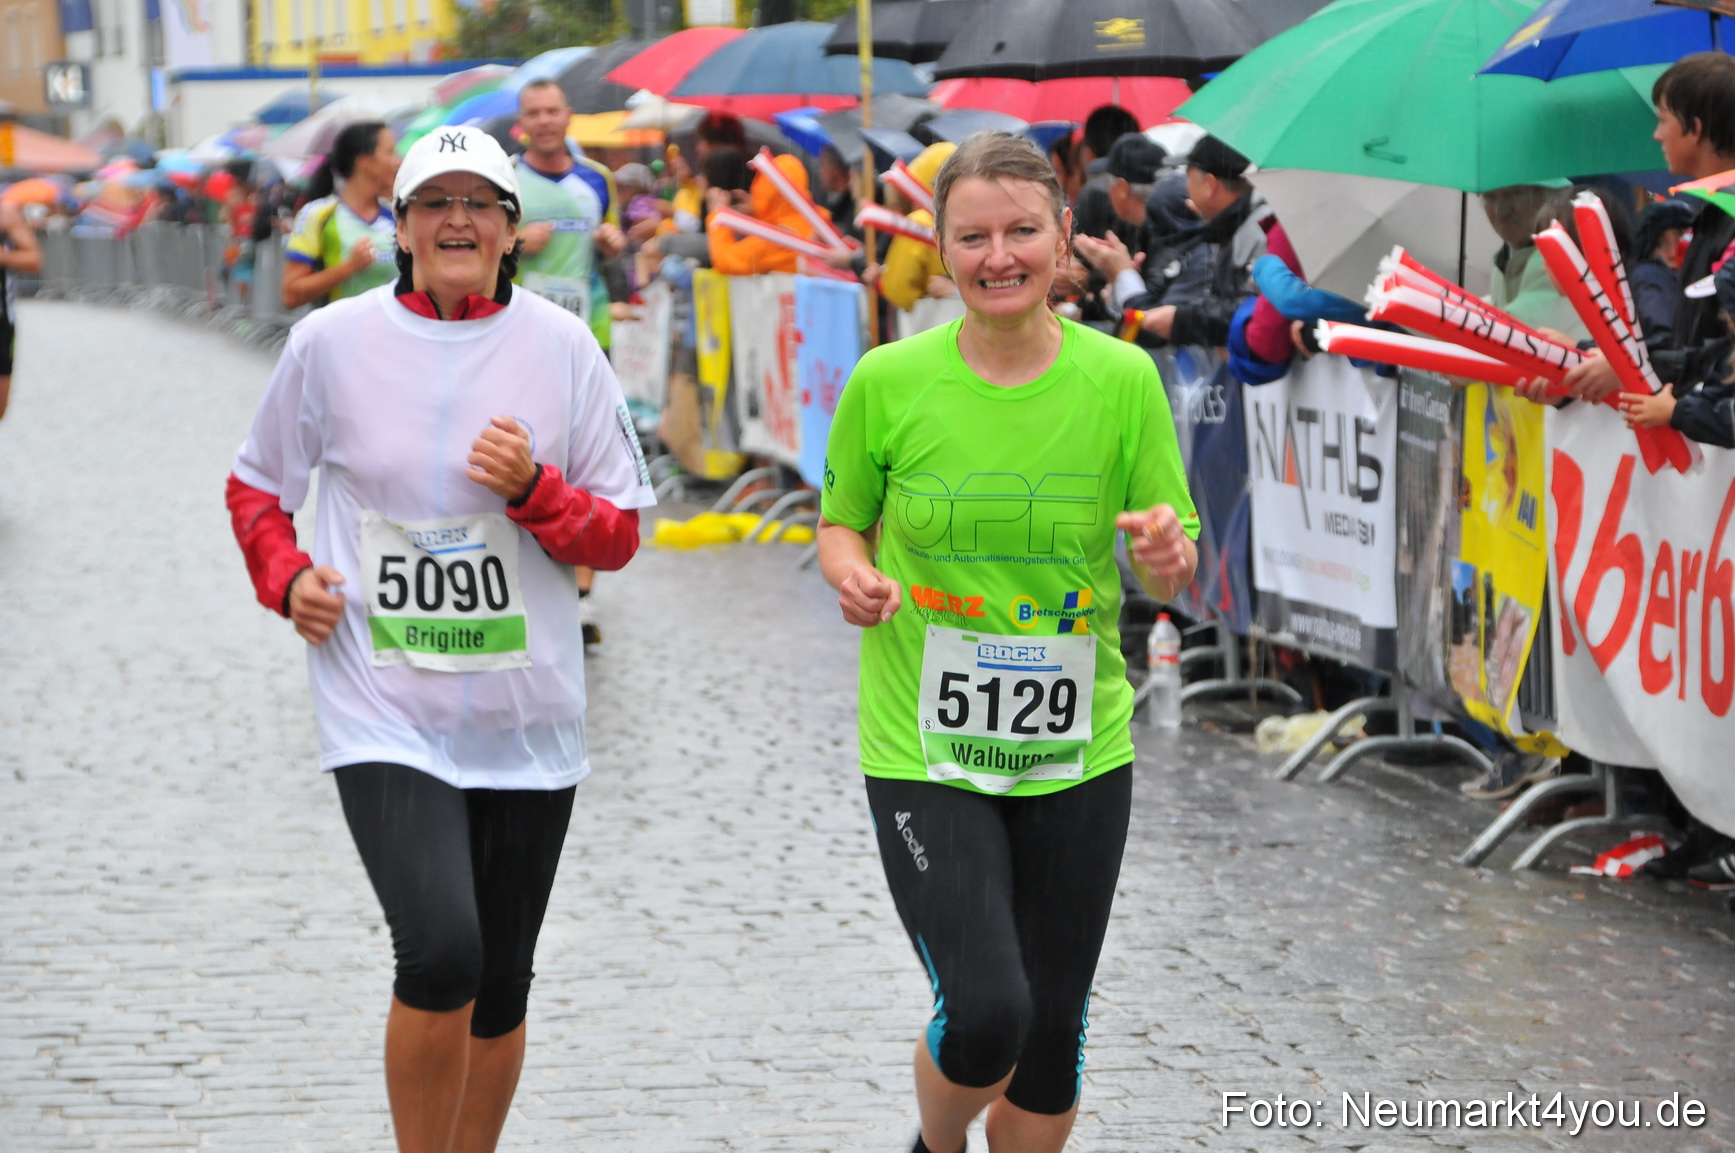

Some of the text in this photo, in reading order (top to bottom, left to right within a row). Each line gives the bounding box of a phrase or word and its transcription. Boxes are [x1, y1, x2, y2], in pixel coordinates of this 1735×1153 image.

[439, 132, 467, 153] NY
[934, 553, 951, 563] und
[953, 553, 1070, 567] Automatisierungstechnik
[377, 555, 510, 612] 5090
[910, 584, 985, 617] MERZ
[1018, 604, 1096, 621] Bretschneider
[406, 626, 485, 653] Brigitte
[977, 643, 1046, 662] BOCK
[937, 671, 1078, 735] 5129
